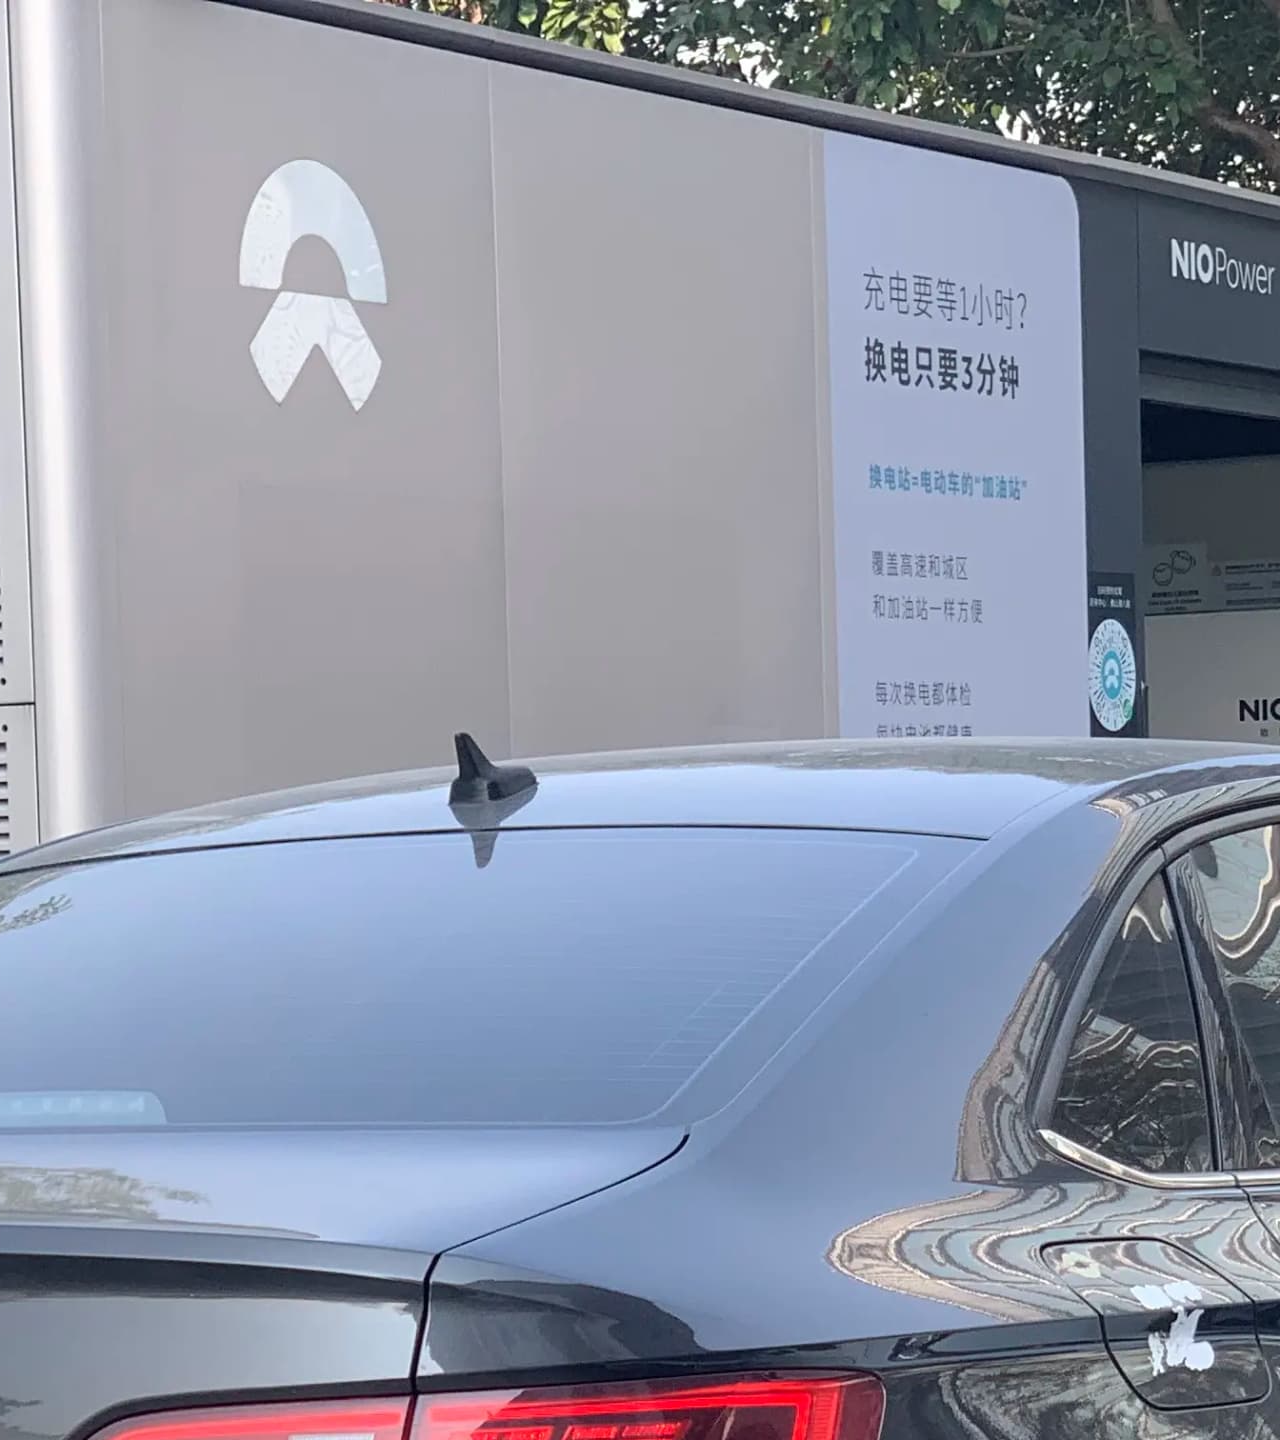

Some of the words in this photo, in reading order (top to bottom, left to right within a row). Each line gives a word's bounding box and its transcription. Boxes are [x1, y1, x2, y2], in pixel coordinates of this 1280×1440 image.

[863, 266, 1027, 330] 充电要等1小时?
[864, 336, 1019, 399] 换电只要3分钟
[871, 550, 968, 580] 覆盖高速和城区
[873, 593, 983, 624] 和加油站一样方便
[875, 680, 971, 706] 每次换电都体检
